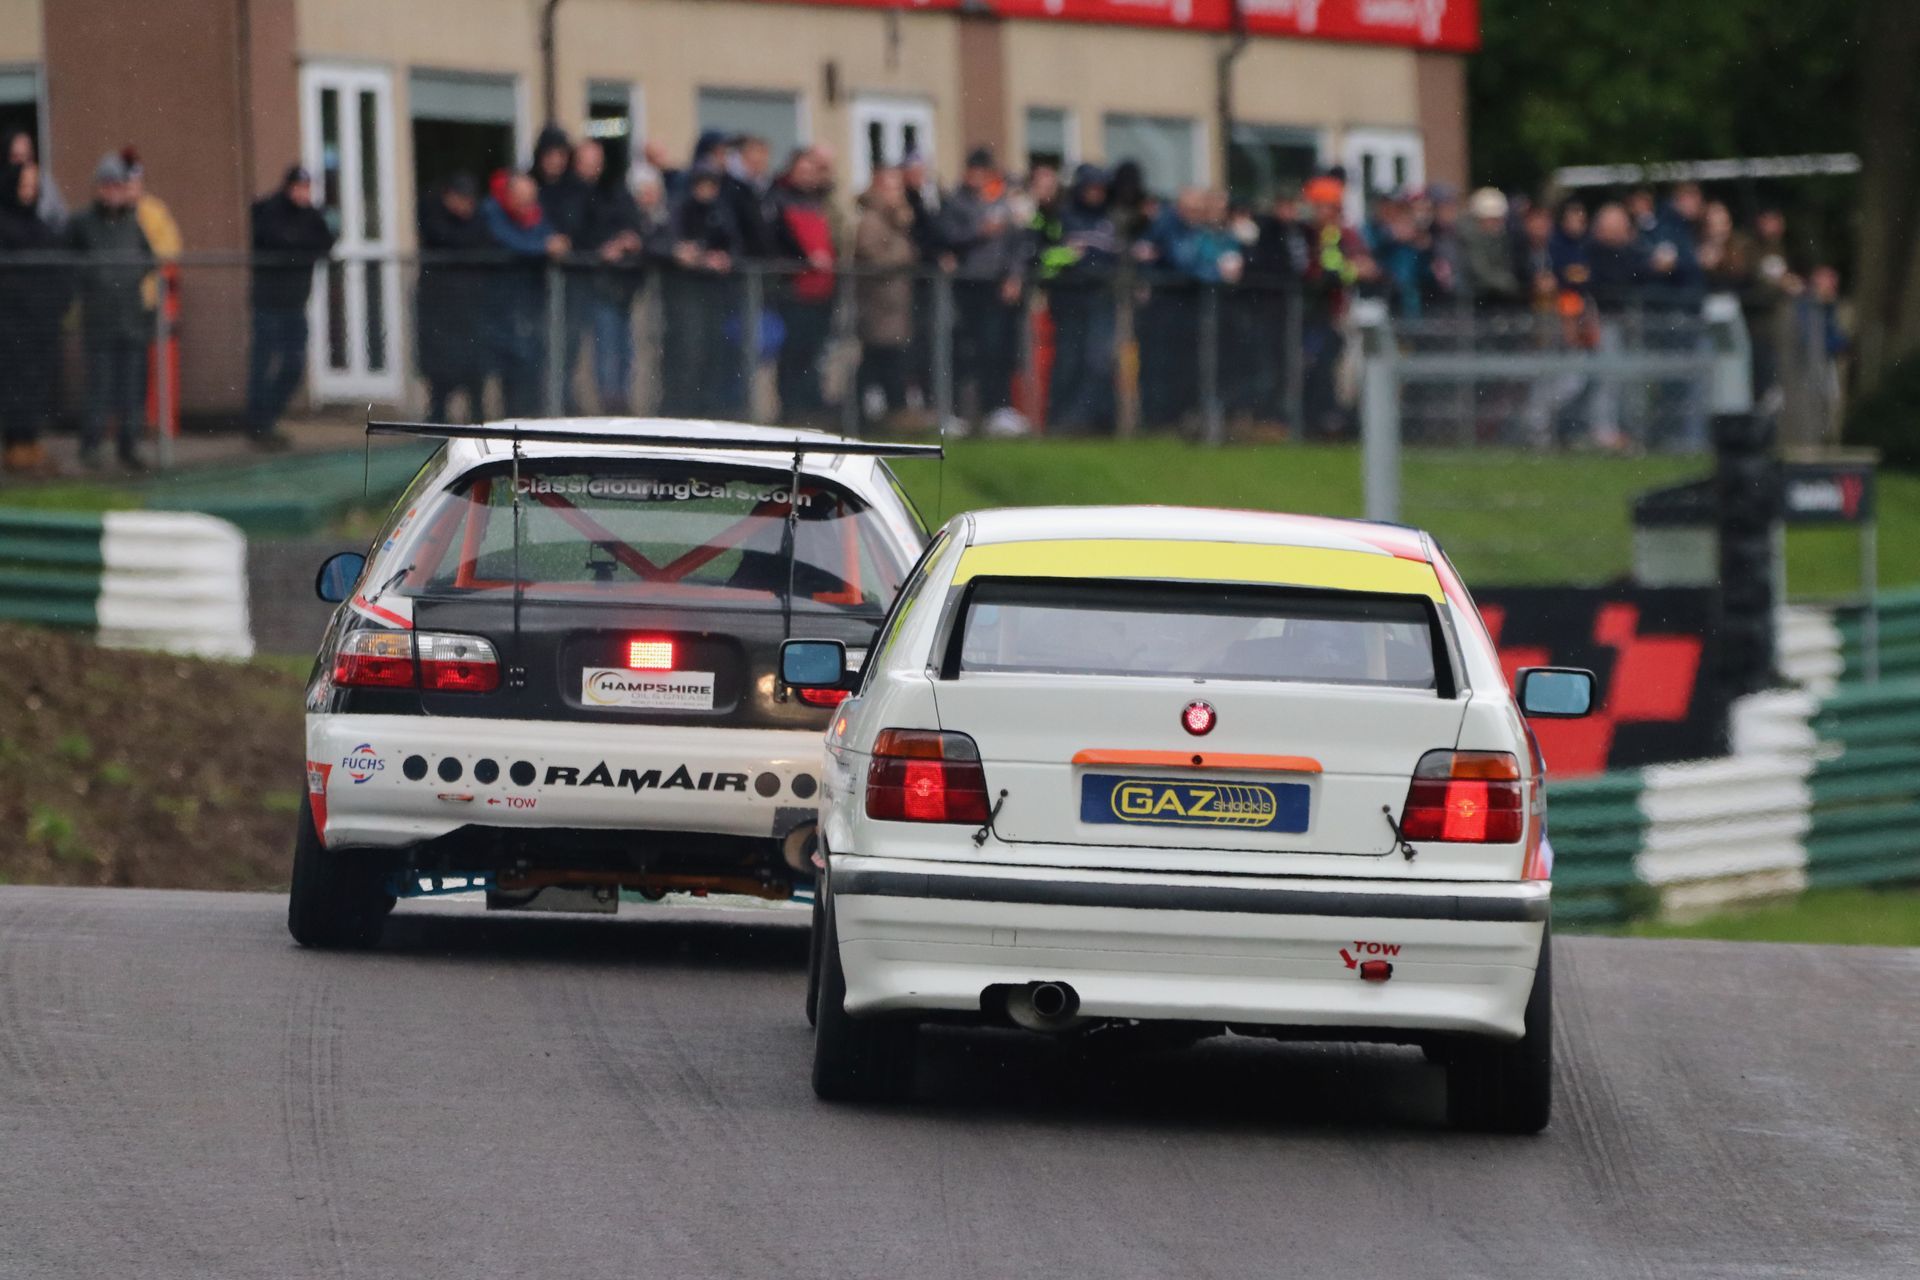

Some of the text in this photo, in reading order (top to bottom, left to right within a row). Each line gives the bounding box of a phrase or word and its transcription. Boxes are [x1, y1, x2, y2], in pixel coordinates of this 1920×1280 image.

[601, 681, 711, 695] HAMPSHIRE
[342, 757, 385, 771] FUCHS
[544, 760, 748, 794] RAMAIR
[506, 797, 537, 809] TOW
[1121, 787, 1272, 817] GAZ SHOCKS
[1353, 941, 1402, 957] TOW
